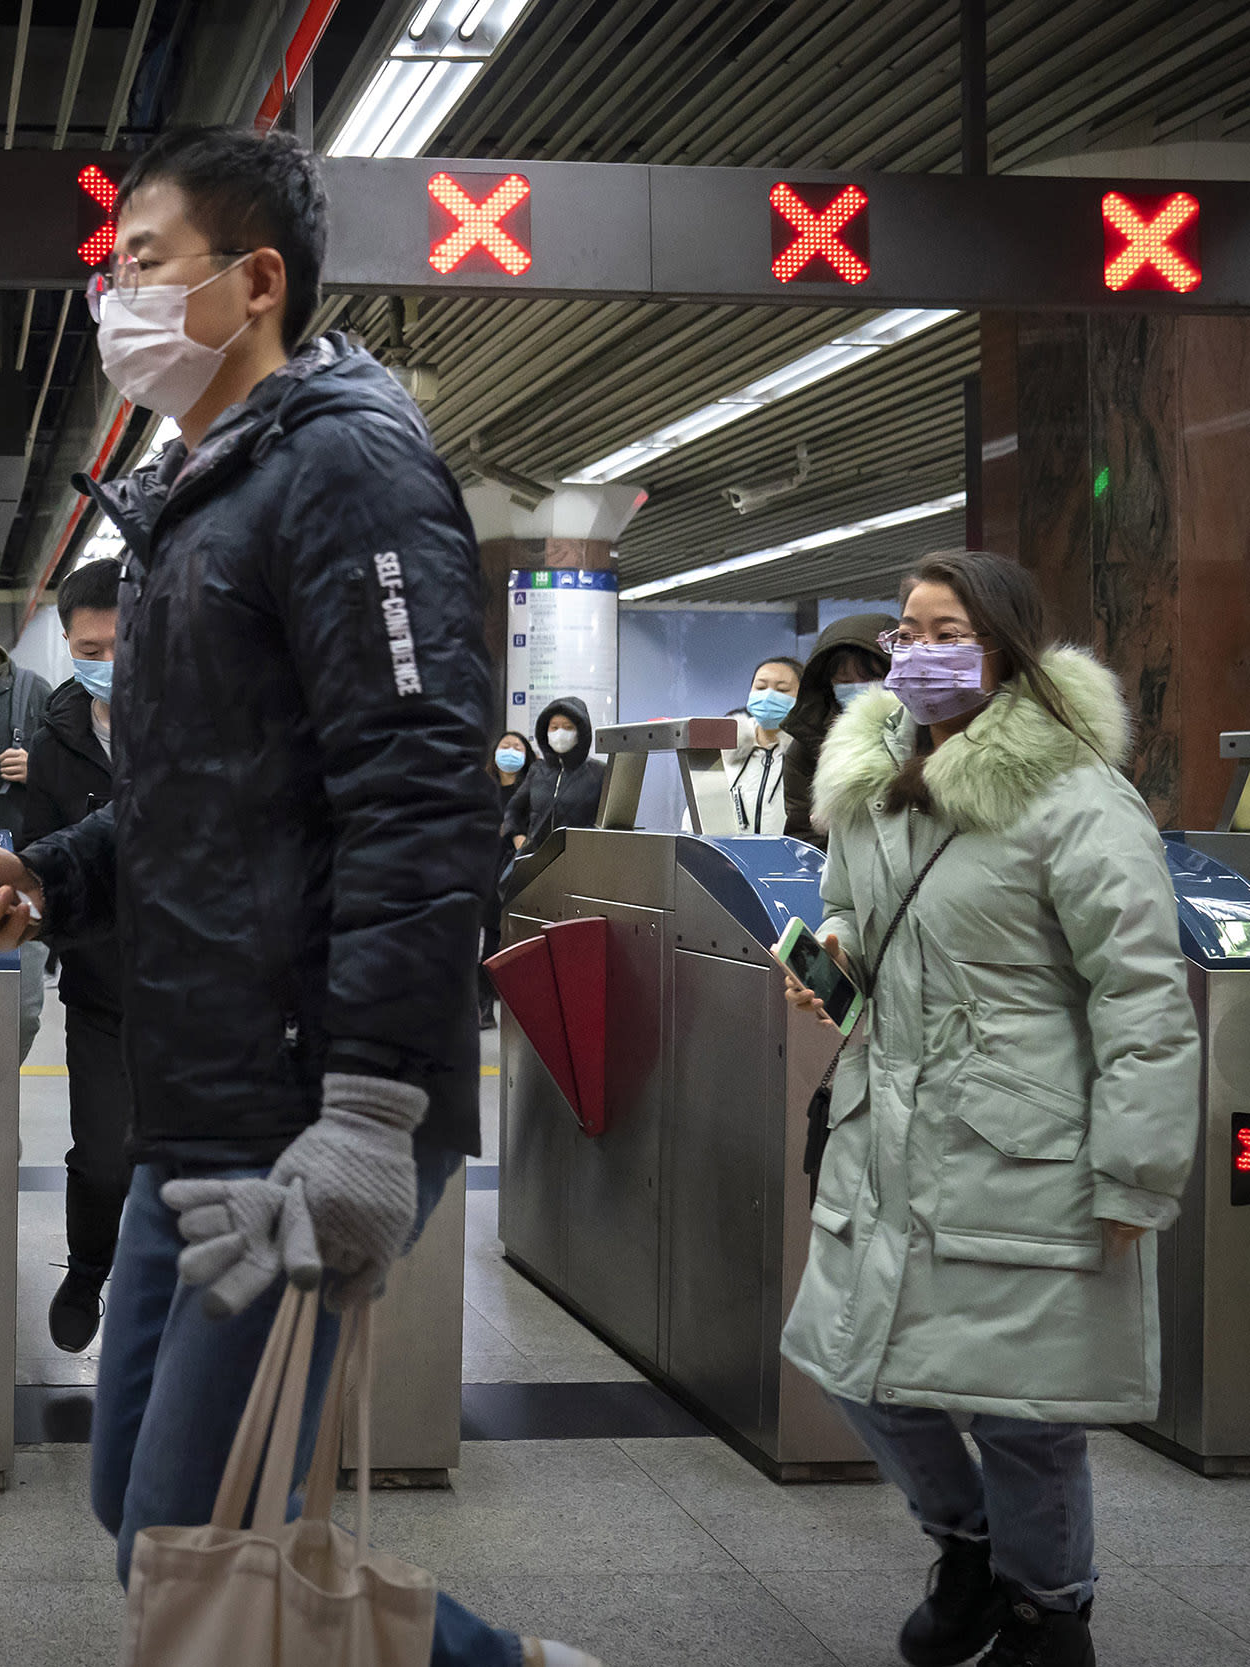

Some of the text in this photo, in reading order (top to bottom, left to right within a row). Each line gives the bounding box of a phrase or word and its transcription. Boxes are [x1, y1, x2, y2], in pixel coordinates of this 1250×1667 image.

[516, 593, 525, 604] A
[374, 552, 422, 697] SELF-CONFIDENCE
[515, 635, 524, 646] B
[514, 693, 524, 704] C
